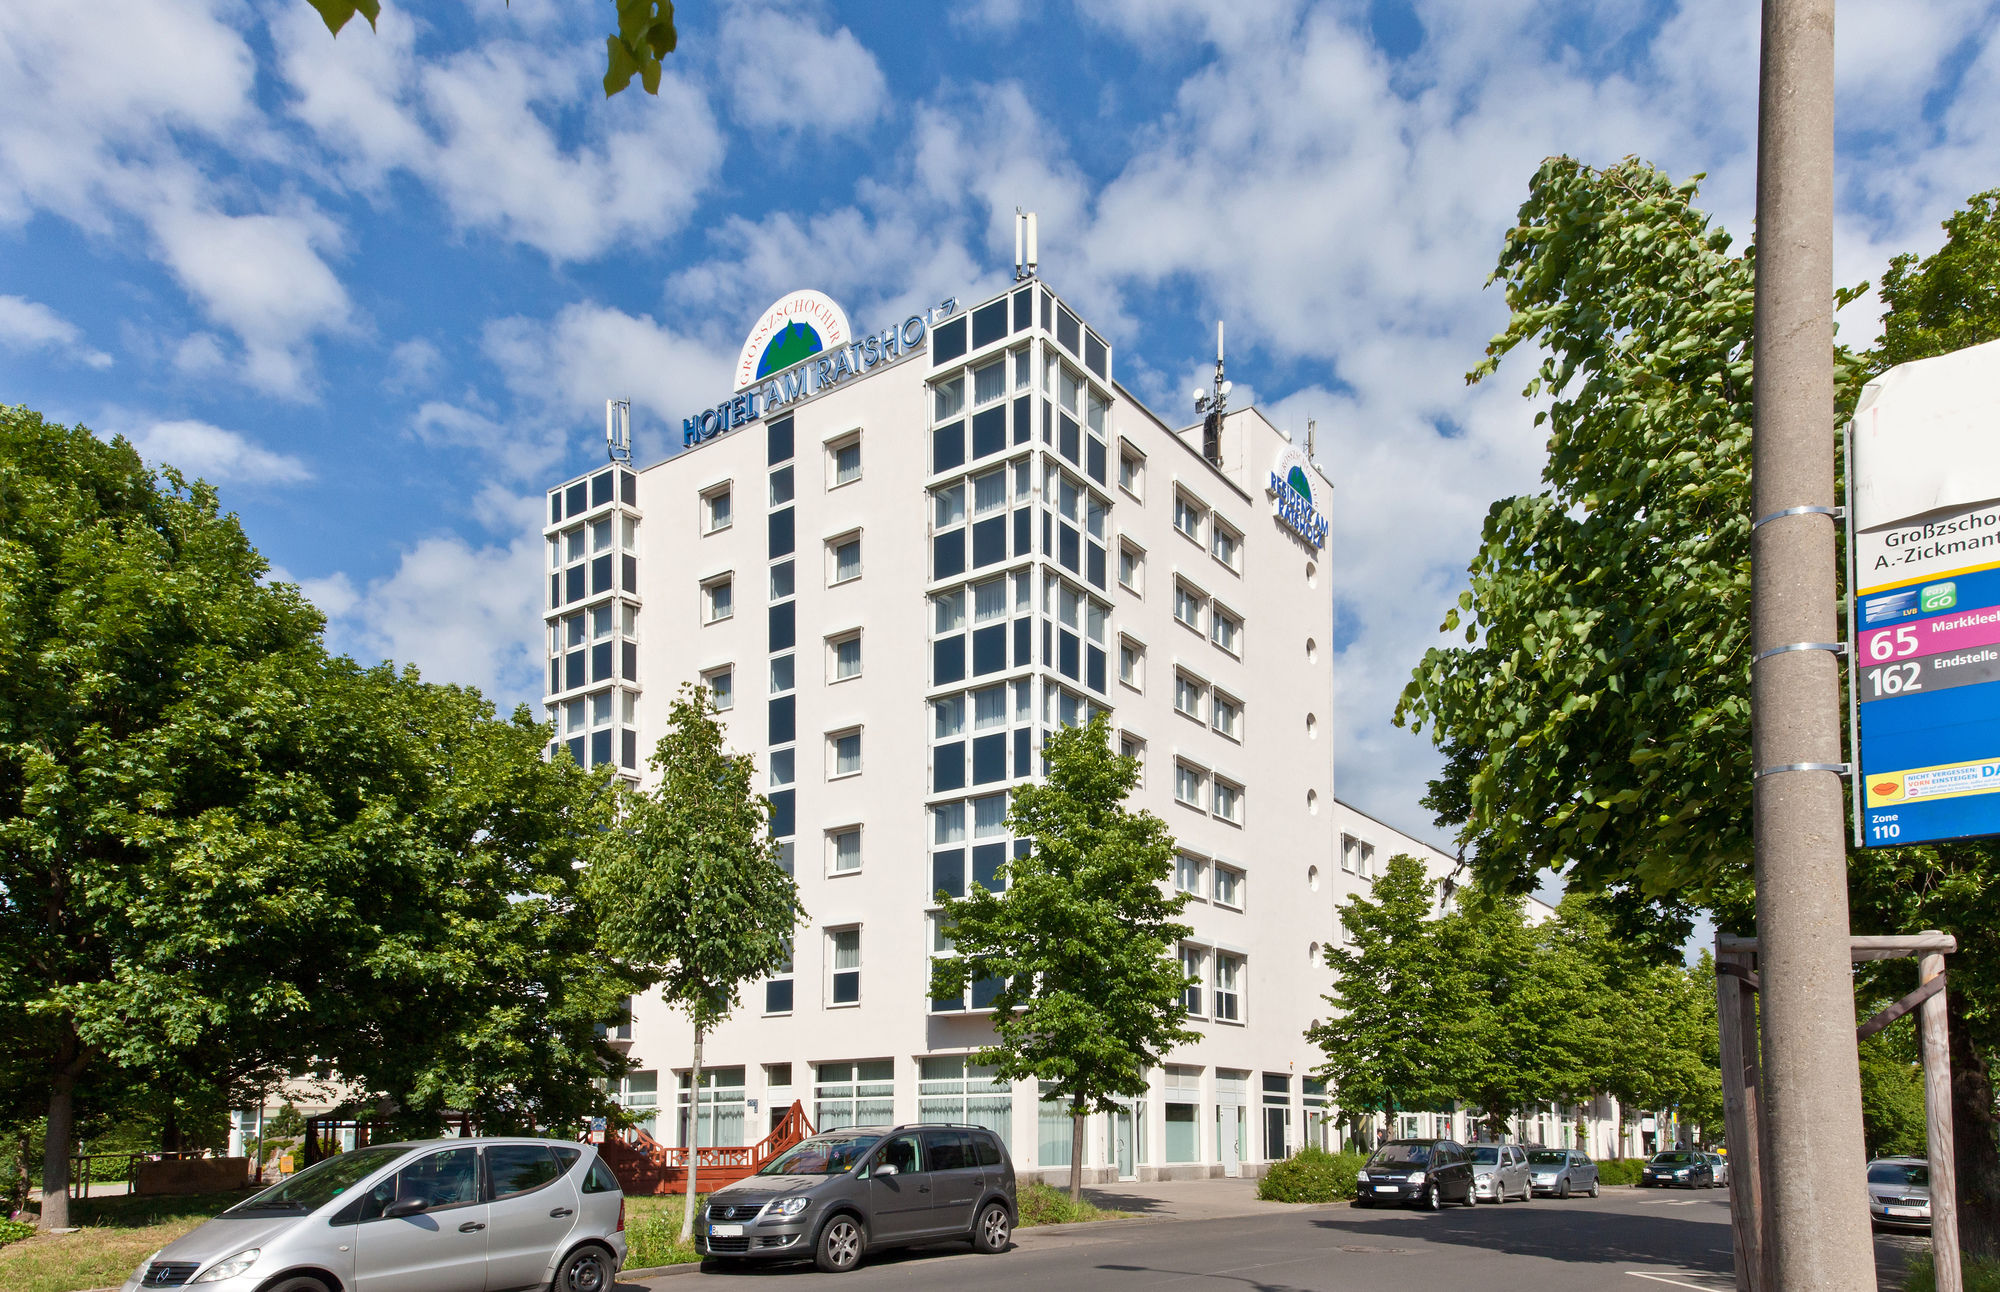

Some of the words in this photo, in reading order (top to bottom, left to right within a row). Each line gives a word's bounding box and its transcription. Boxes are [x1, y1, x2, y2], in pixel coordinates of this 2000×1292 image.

[740, 299, 841, 386] GROSSZSCHOCHER
[683, 391, 759, 448] HOTEL
[764, 366, 809, 413] AM
[1278, 497, 1323, 549] RATSHOLZ
[1315, 512, 1328, 537] AM
[1885, 514, 2000, 547] Großzscho
[1902, 607, 1918, 617] LVB
[1925, 594, 1953, 609] GO
[1870, 625, 1918, 660] 65
[1868, 662, 1922, 697] 162
[1934, 650, 1998, 669] Endstelle
[1908, 773, 1930, 781] NICHT
[1908, 780, 1930, 788] VORN
[1932, 773, 1978, 785] EINSTEIGEN
[1872, 814, 1899, 824] Zone
[1872, 823, 1901, 840] 110
